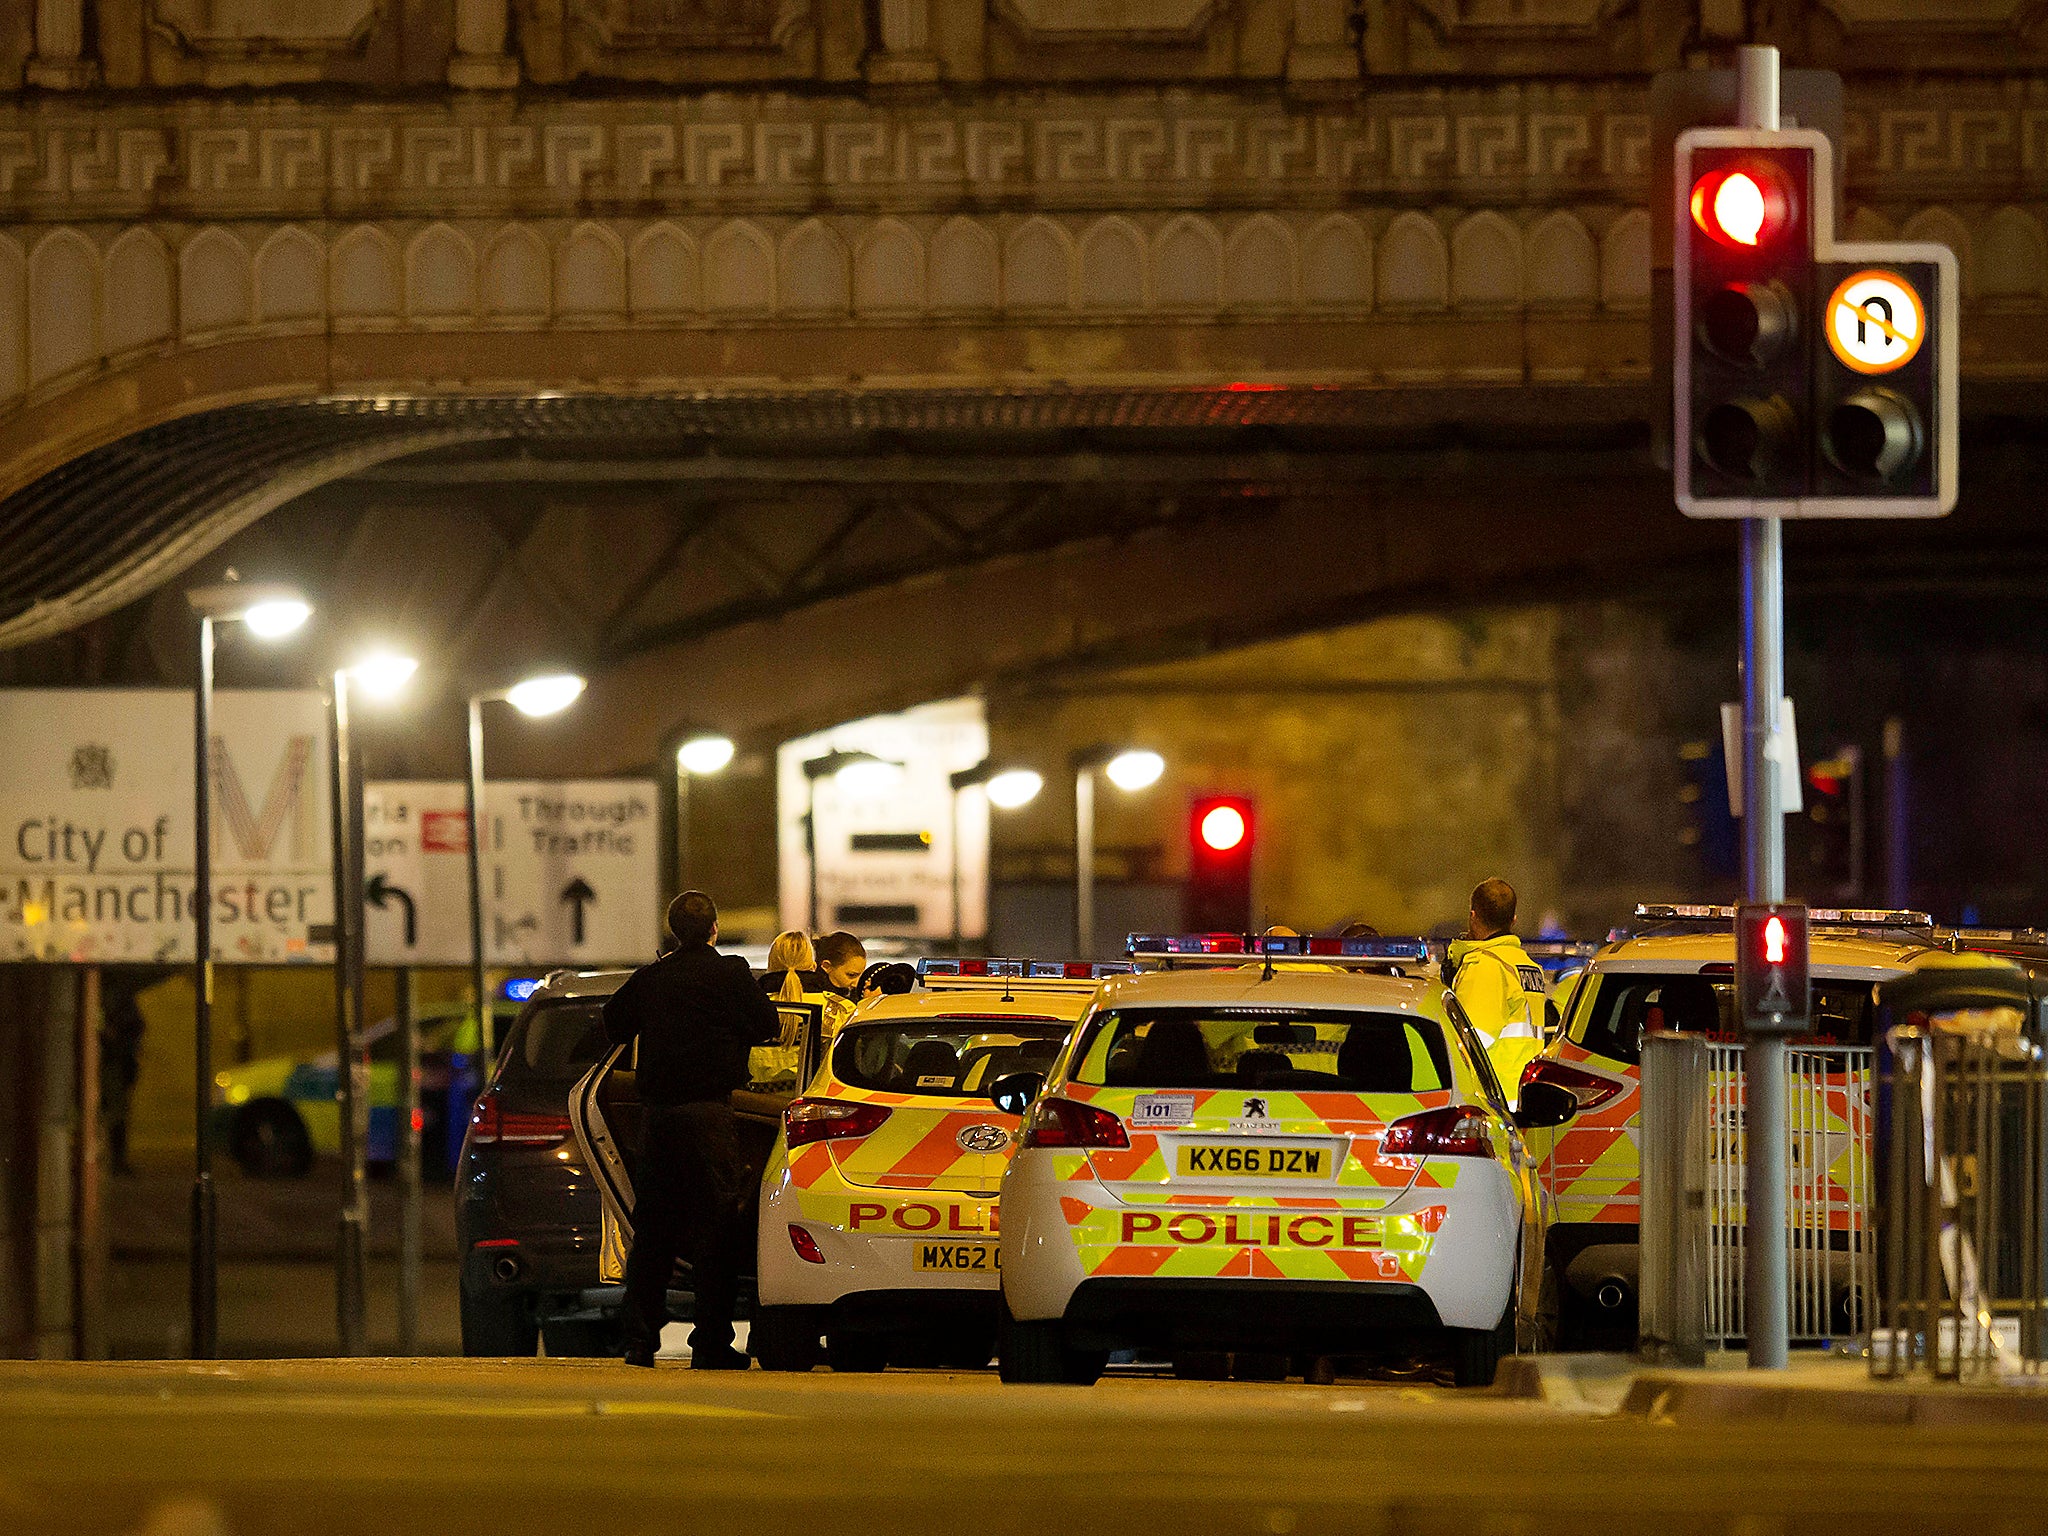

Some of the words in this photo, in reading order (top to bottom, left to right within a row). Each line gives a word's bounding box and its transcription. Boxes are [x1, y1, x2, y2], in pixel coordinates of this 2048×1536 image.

[518, 796, 648, 826] Through
[17, 812, 104, 874] City
[121, 813, 170, 863] of
[530, 829, 636, 856] Traffic
[16, 873, 318, 923] Manchester
[1518, 969, 1546, 992] POLIC
[1144, 1104, 1170, 1117] 101
[1189, 1148, 1260, 1171] KX66
[1268, 1149, 1320, 1173] DZW
[849, 1202, 1000, 1232] POLI
[1121, 1211, 1382, 1248] POLICE
[922, 1245, 986, 1269] MX62
